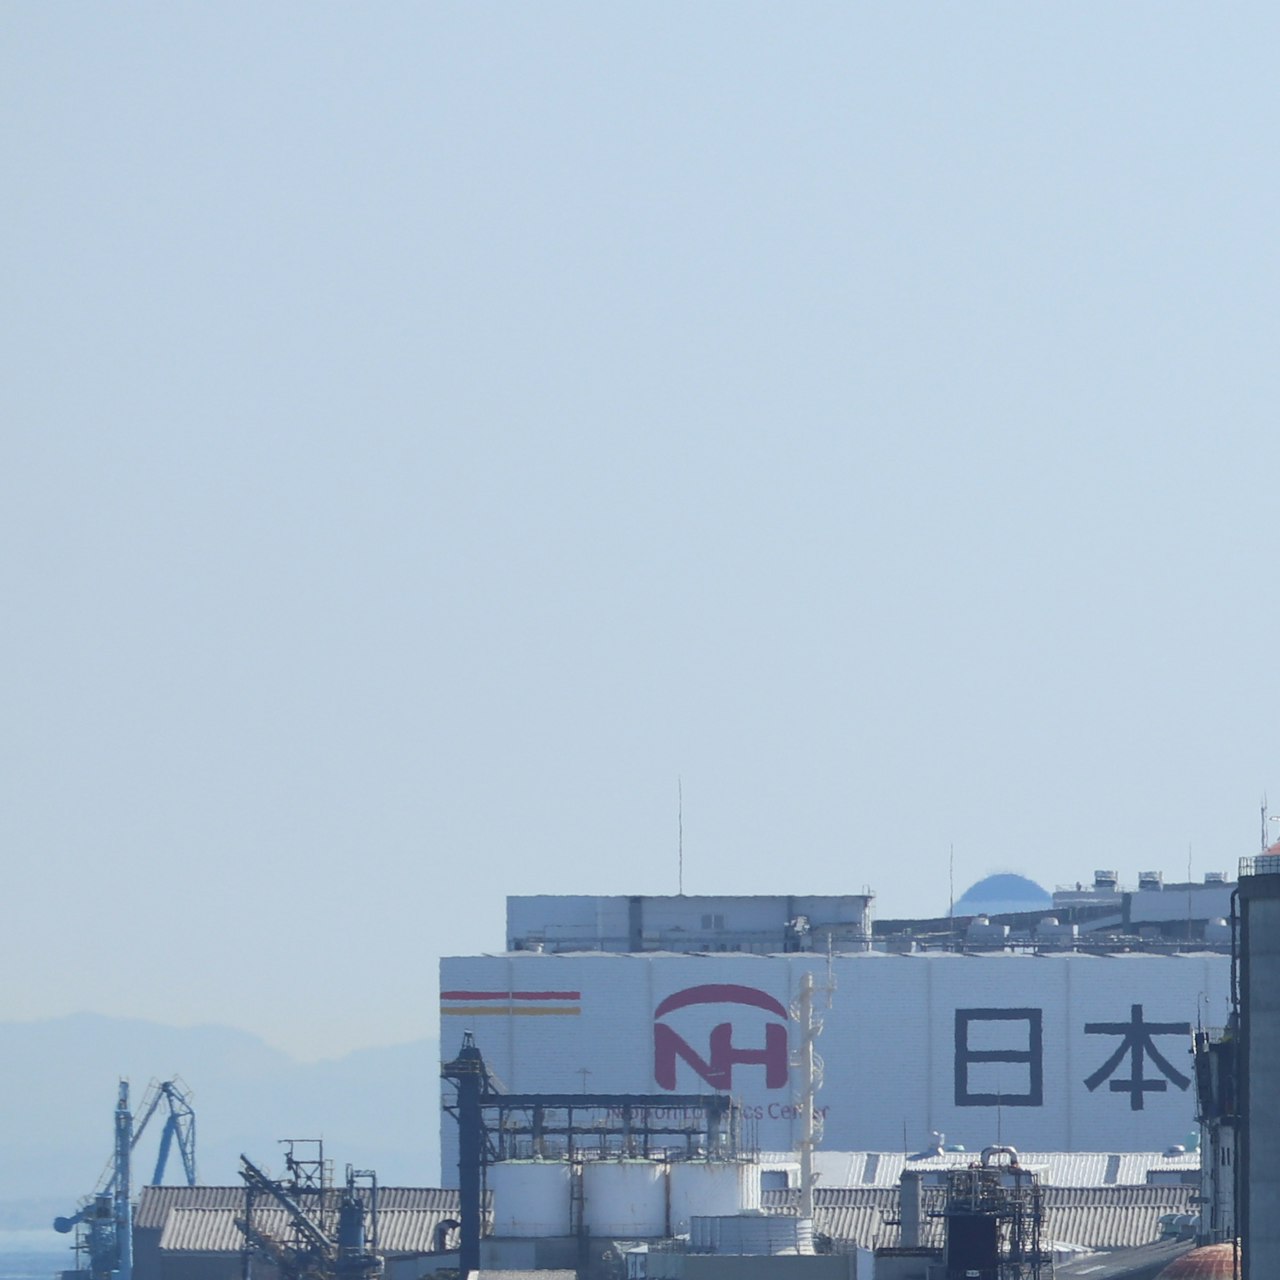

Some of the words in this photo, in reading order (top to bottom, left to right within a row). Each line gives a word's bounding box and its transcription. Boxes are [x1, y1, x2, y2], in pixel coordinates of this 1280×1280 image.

[654, 1022, 788, 1091] NH
[954, 1004, 1191, 1111] 日本
[767, 1103, 830, 1120] Cenr
